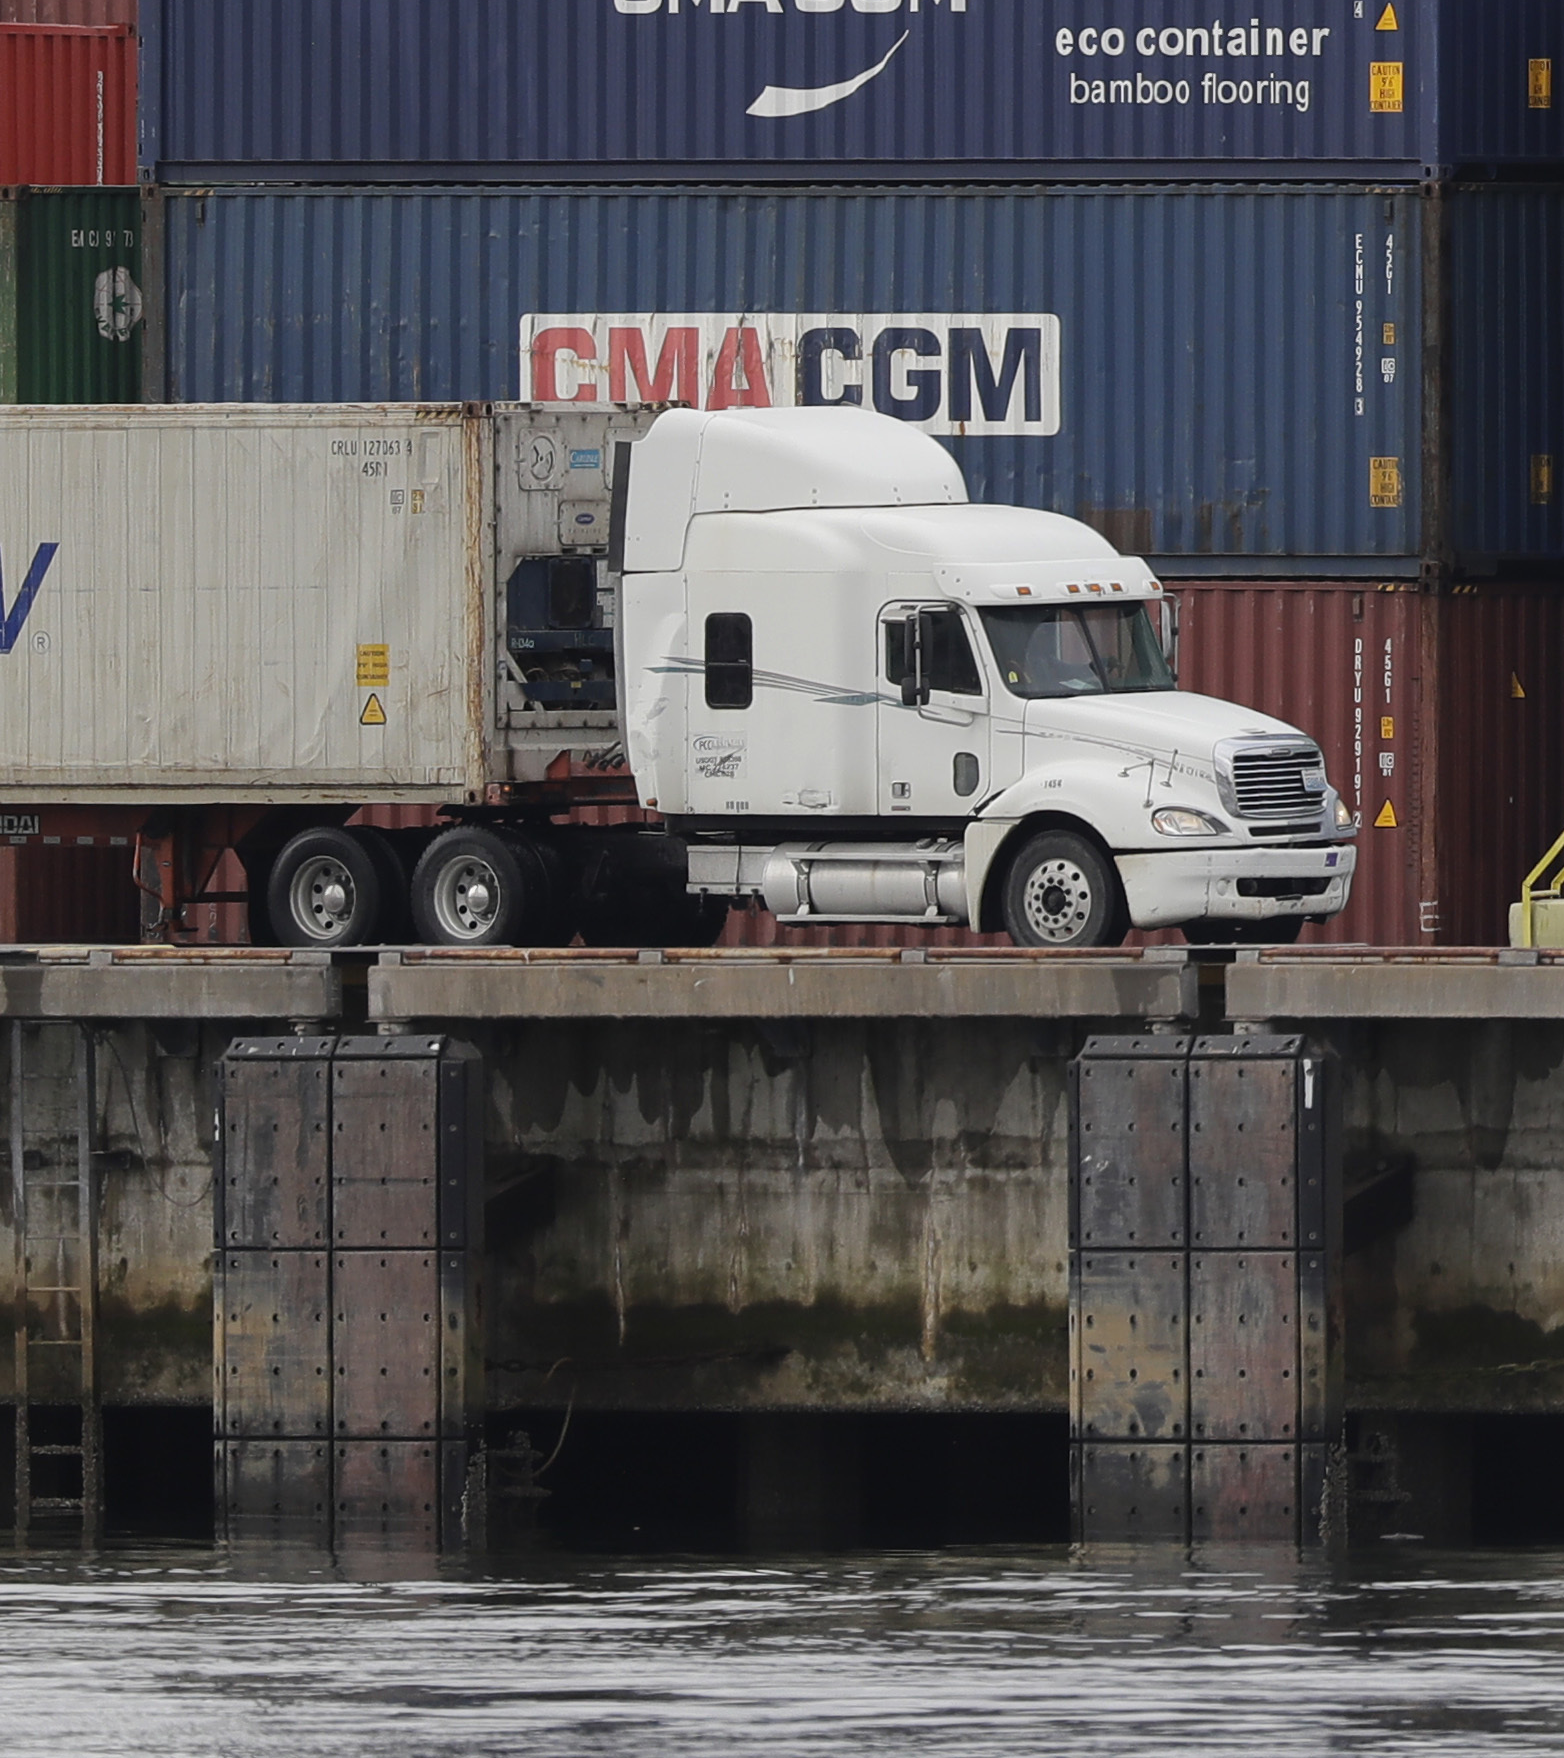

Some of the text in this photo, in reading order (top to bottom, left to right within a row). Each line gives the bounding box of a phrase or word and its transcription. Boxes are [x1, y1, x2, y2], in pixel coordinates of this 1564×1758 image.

[1055, 18, 1330, 57] eco container
[1070, 72, 1310, 112] bamboo flooring
[1355, 233, 1363, 294] ECMU
[1385, 233, 1393, 294] 45G1
[532, 326, 1043, 422] CMA CGM
[1355, 300, 1363, 393] 954928
[331, 440, 358, 456] CRLU
[363, 440, 400, 456] 127063
[1354, 638, 1362, 703] DRYU
[1384, 638, 1392, 703] 45G1
[1354, 708, 1362, 806] 929191
